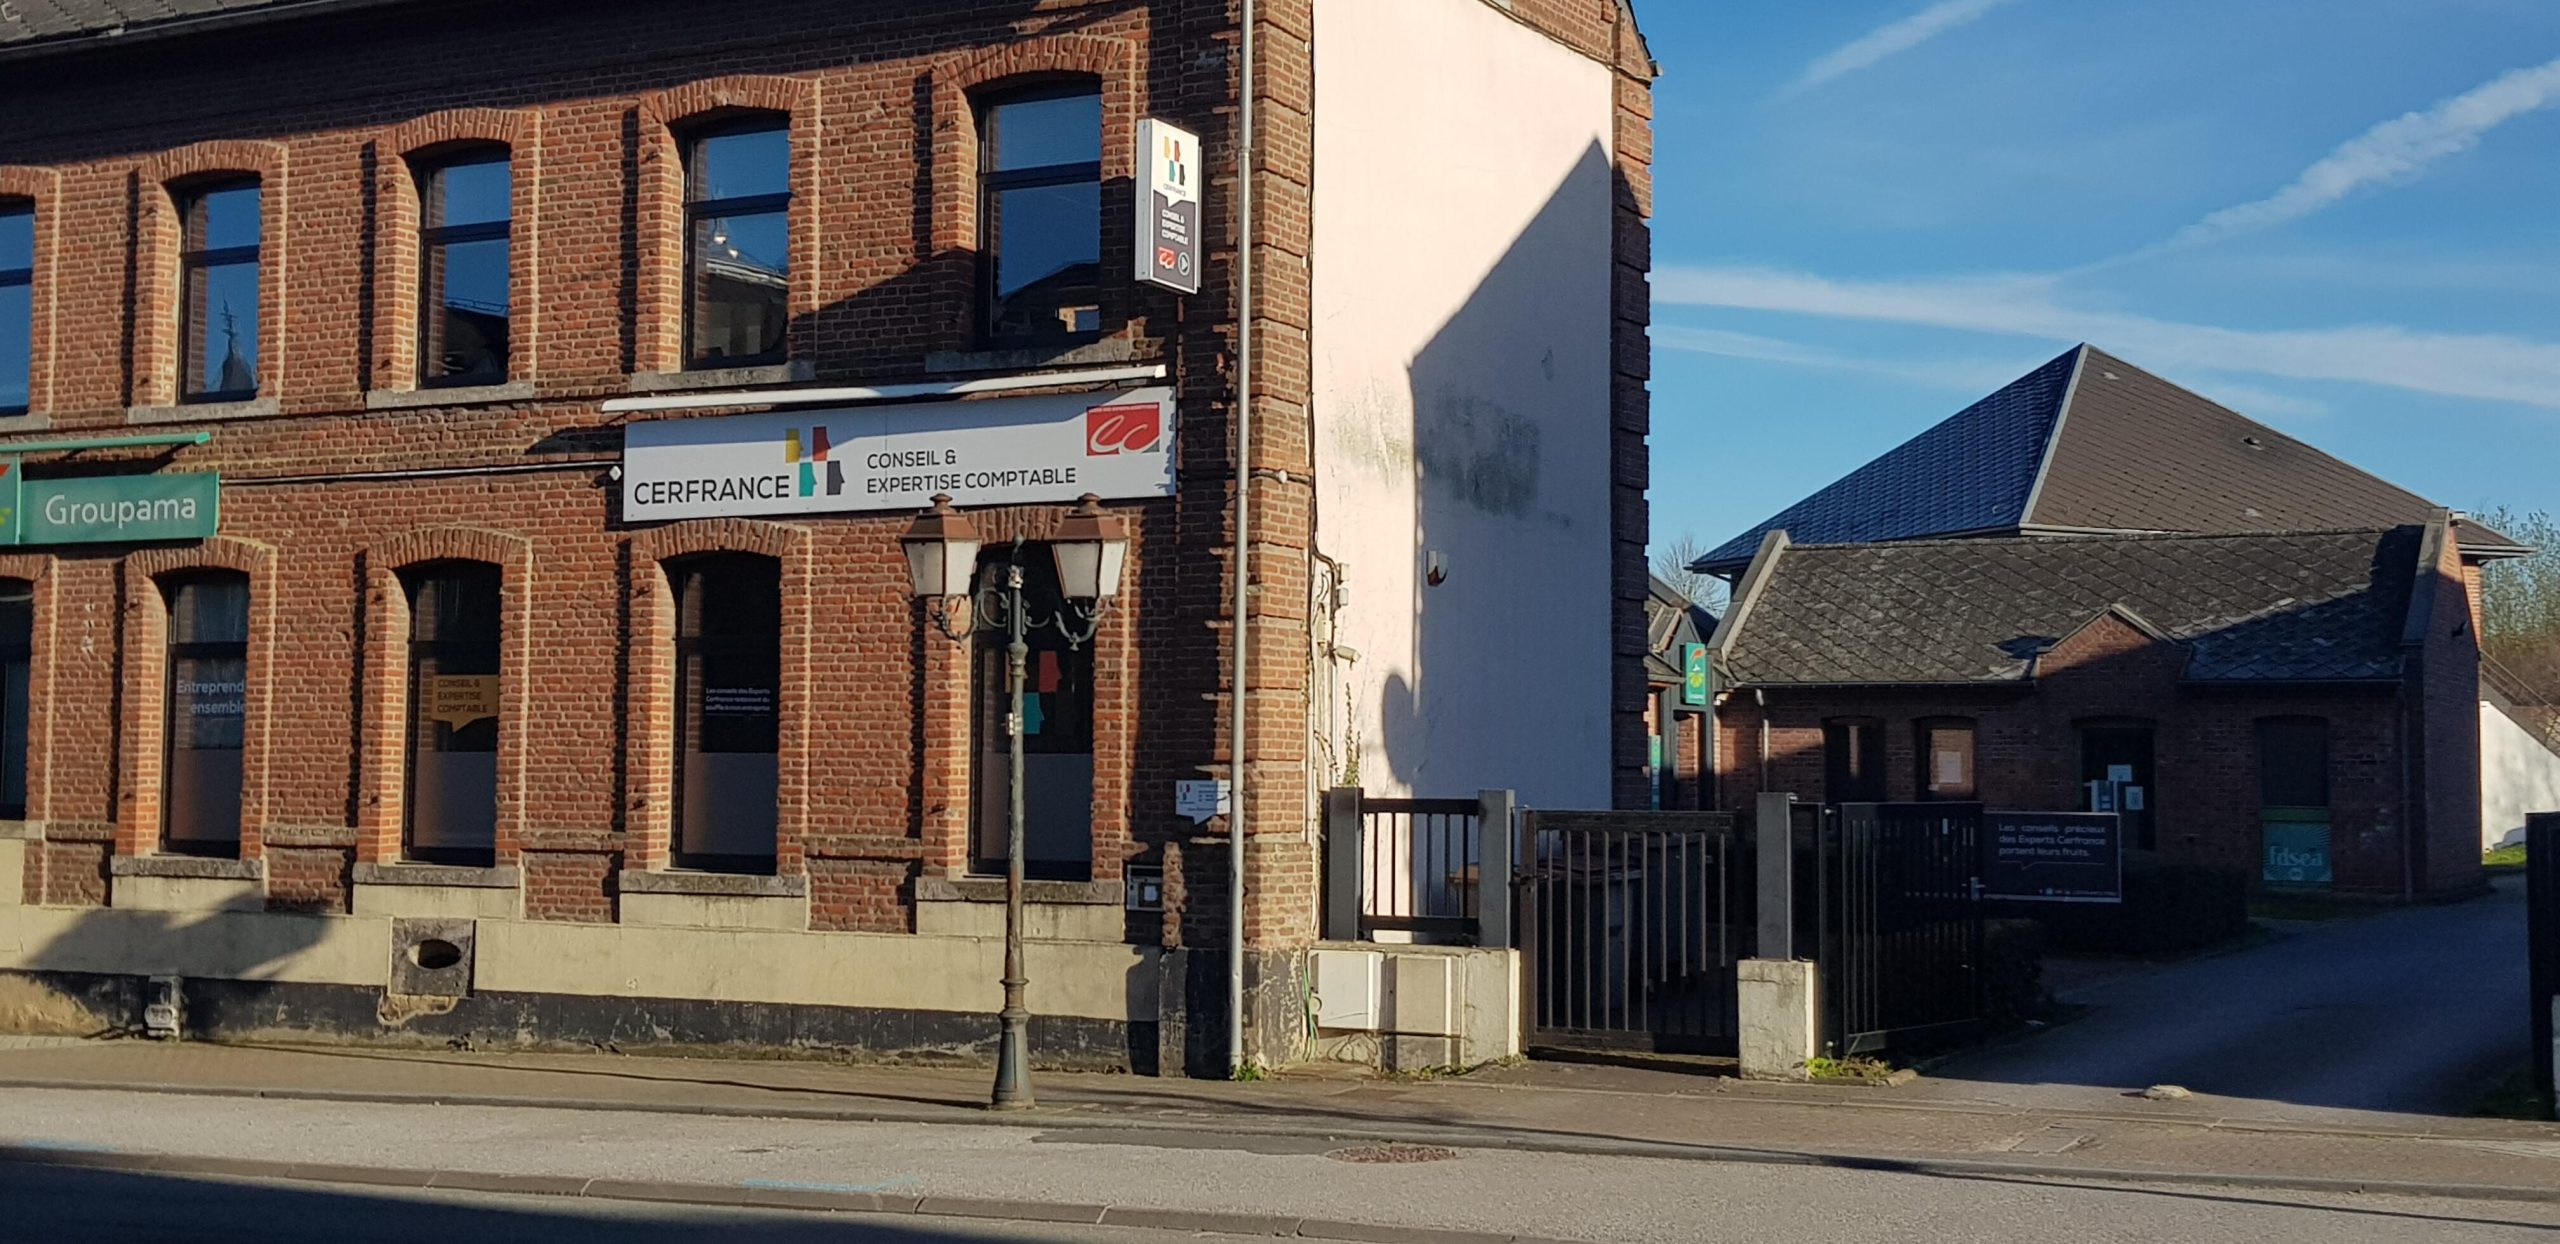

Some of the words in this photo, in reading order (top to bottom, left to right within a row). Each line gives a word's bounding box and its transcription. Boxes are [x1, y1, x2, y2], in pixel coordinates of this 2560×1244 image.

[867, 450, 940, 469] CONSEIL
[945, 449, 957, 465] &
[867, 474, 961, 493] EXPERTISE
[965, 467, 1076, 489] COMPTABLE
[634, 475, 790, 505] CERFRANCE
[45, 494, 196, 529] Groupama
[438, 679, 473, 687] CONSEIL
[437, 691, 481, 700] EXPERTISE
[437, 704, 487, 713] COMPTABLE
[1999, 823, 2016, 832] Les
[2021, 824, 2059, 833] conseils
[2064, 824, 2106, 834] précieux
[1999, 835, 2016, 843] des
[2018, 835, 2055, 845] Experts
[2057, 835, 2106, 845] Cerfrance
[1999, 847, 2036, 857] portent
[2036, 847, 2061, 856] leurs
